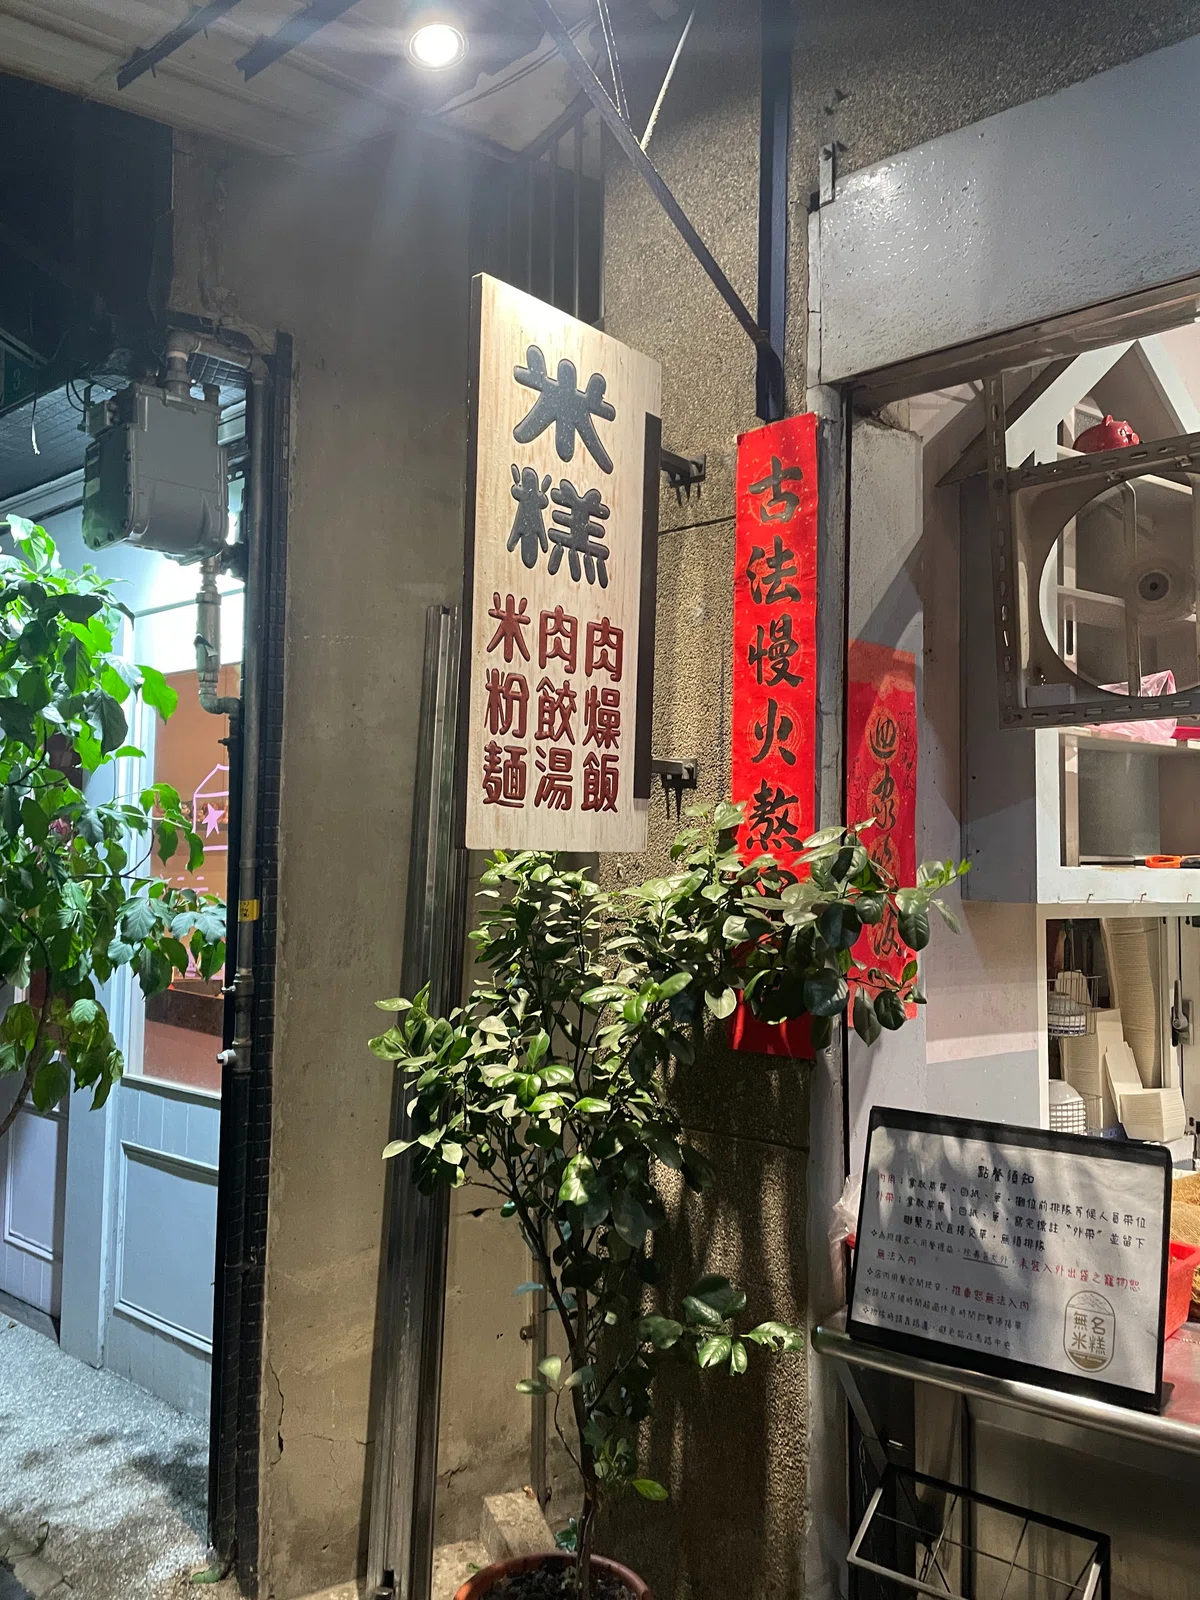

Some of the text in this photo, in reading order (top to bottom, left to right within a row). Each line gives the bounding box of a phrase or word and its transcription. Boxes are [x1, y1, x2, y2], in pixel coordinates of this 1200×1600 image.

[507, 344, 616, 589] 米糕
[482, 592, 531, 808] 米粉麵
[534, 605, 578, 811] 肉餃湯
[581, 617, 624, 813] 肉燥飯
[746, 455, 806, 896] 古法慢火熬
[977, 1165, 1035, 1186] 點餐須知
[1071, 1331, 1106, 1356] 米糕
[1073, 1311, 1106, 1335] 無名
